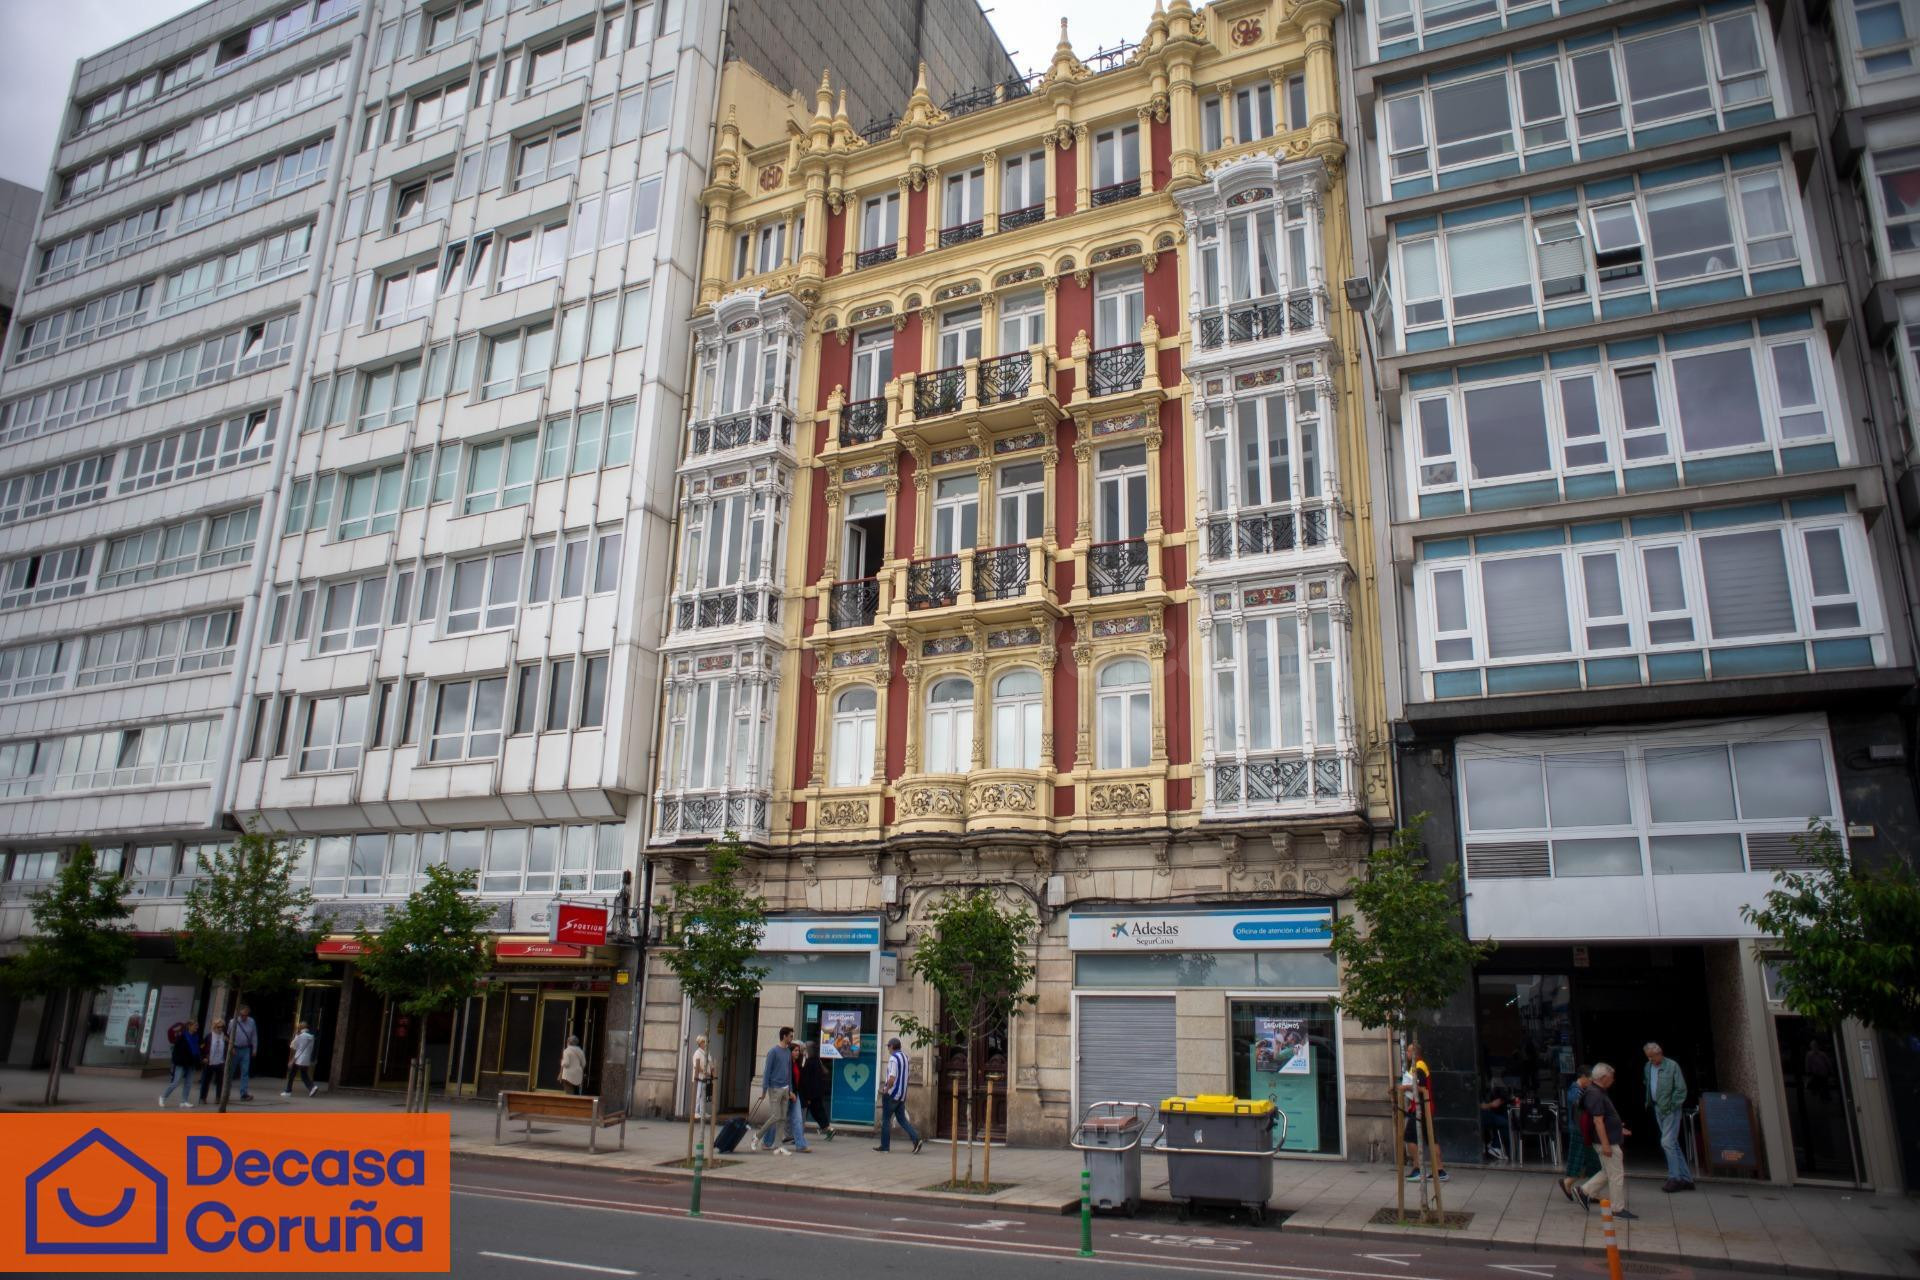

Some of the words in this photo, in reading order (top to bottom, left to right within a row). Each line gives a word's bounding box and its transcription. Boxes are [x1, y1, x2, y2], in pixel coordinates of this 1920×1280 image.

[1132, 921, 1179, 936] Adeslas
[1236, 927, 1258, 935] Oficina
[1258, 927, 1267, 935] de
[1267, 926, 1294, 935] atención
[1295, 926, 1301, 934] al
[1136, 937, 1174, 946] SegurCaixa
